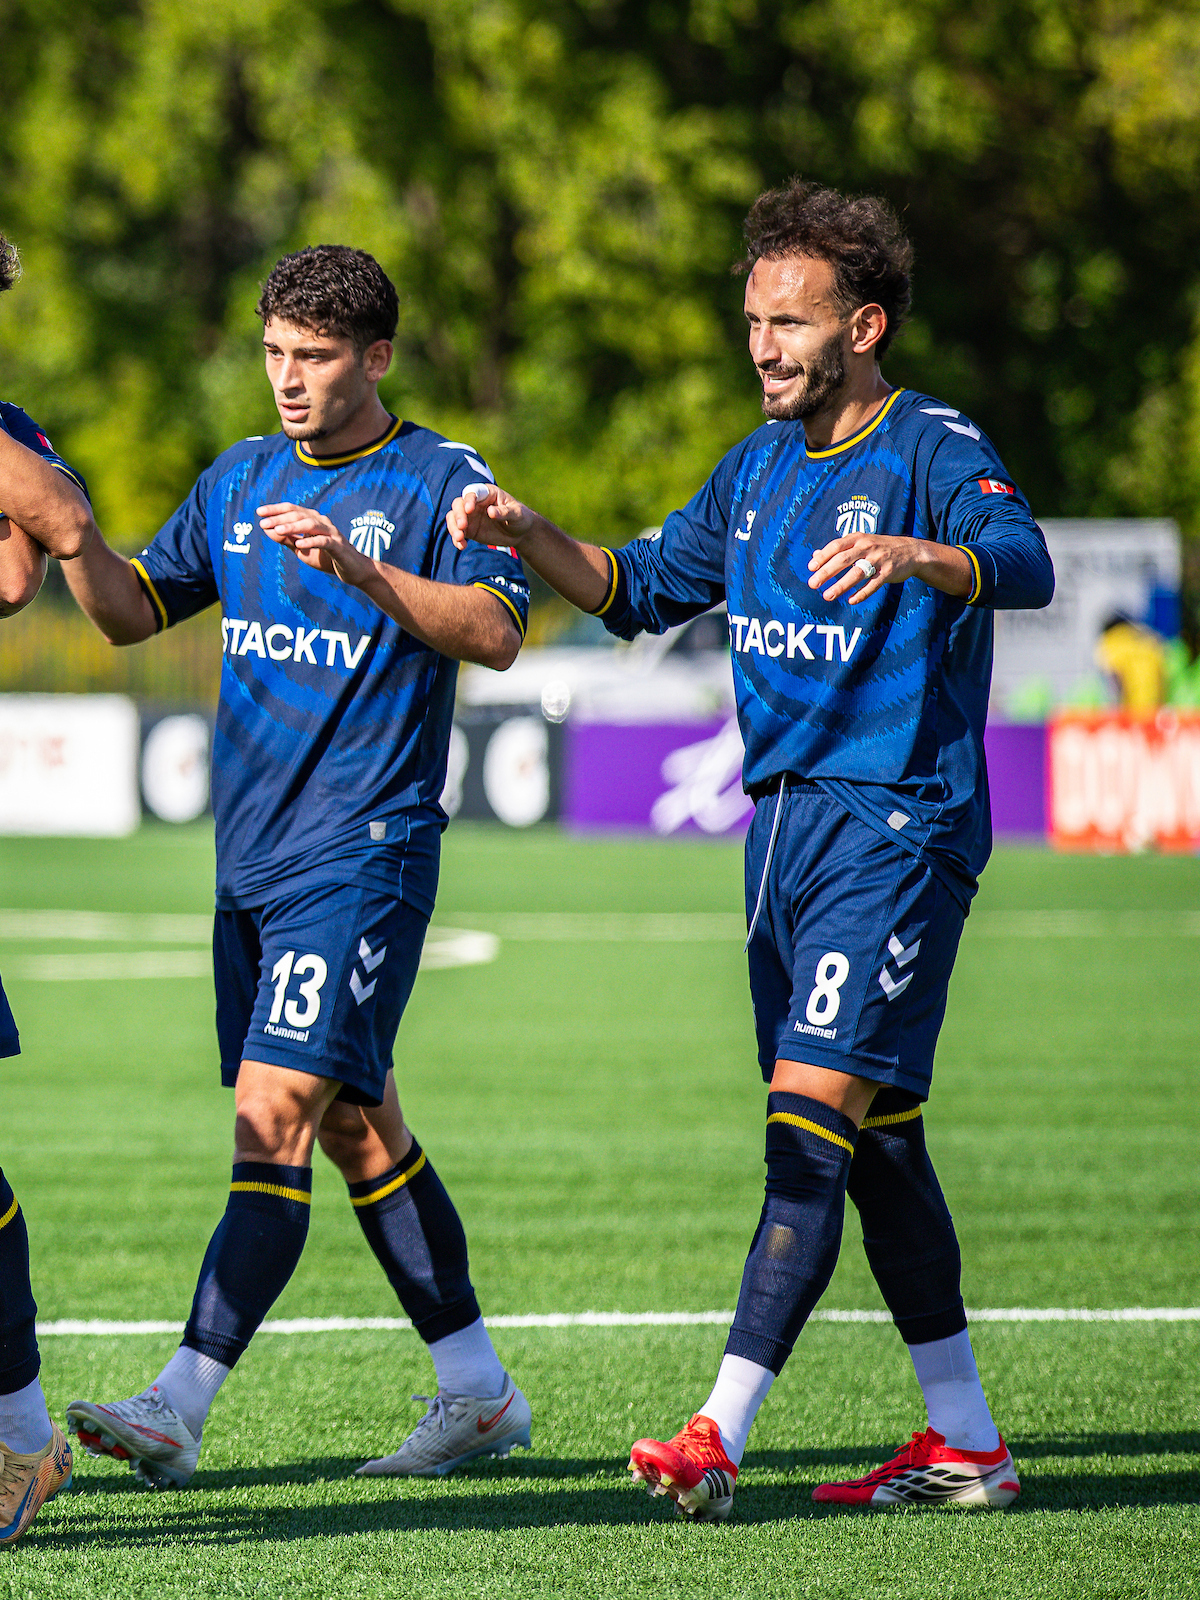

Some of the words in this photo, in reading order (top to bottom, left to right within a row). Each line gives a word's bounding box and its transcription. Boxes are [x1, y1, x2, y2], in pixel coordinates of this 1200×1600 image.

[836, 500, 879, 515] TORONTO
[350, 516, 395, 533] TORONTO
[727, 612, 862, 662] TACKTV
[268, 951, 327, 1028] 13
[805, 951, 850, 1026] 8
[263, 1022, 309, 1042] hummel
[793, 1019, 837, 1040] hummel
